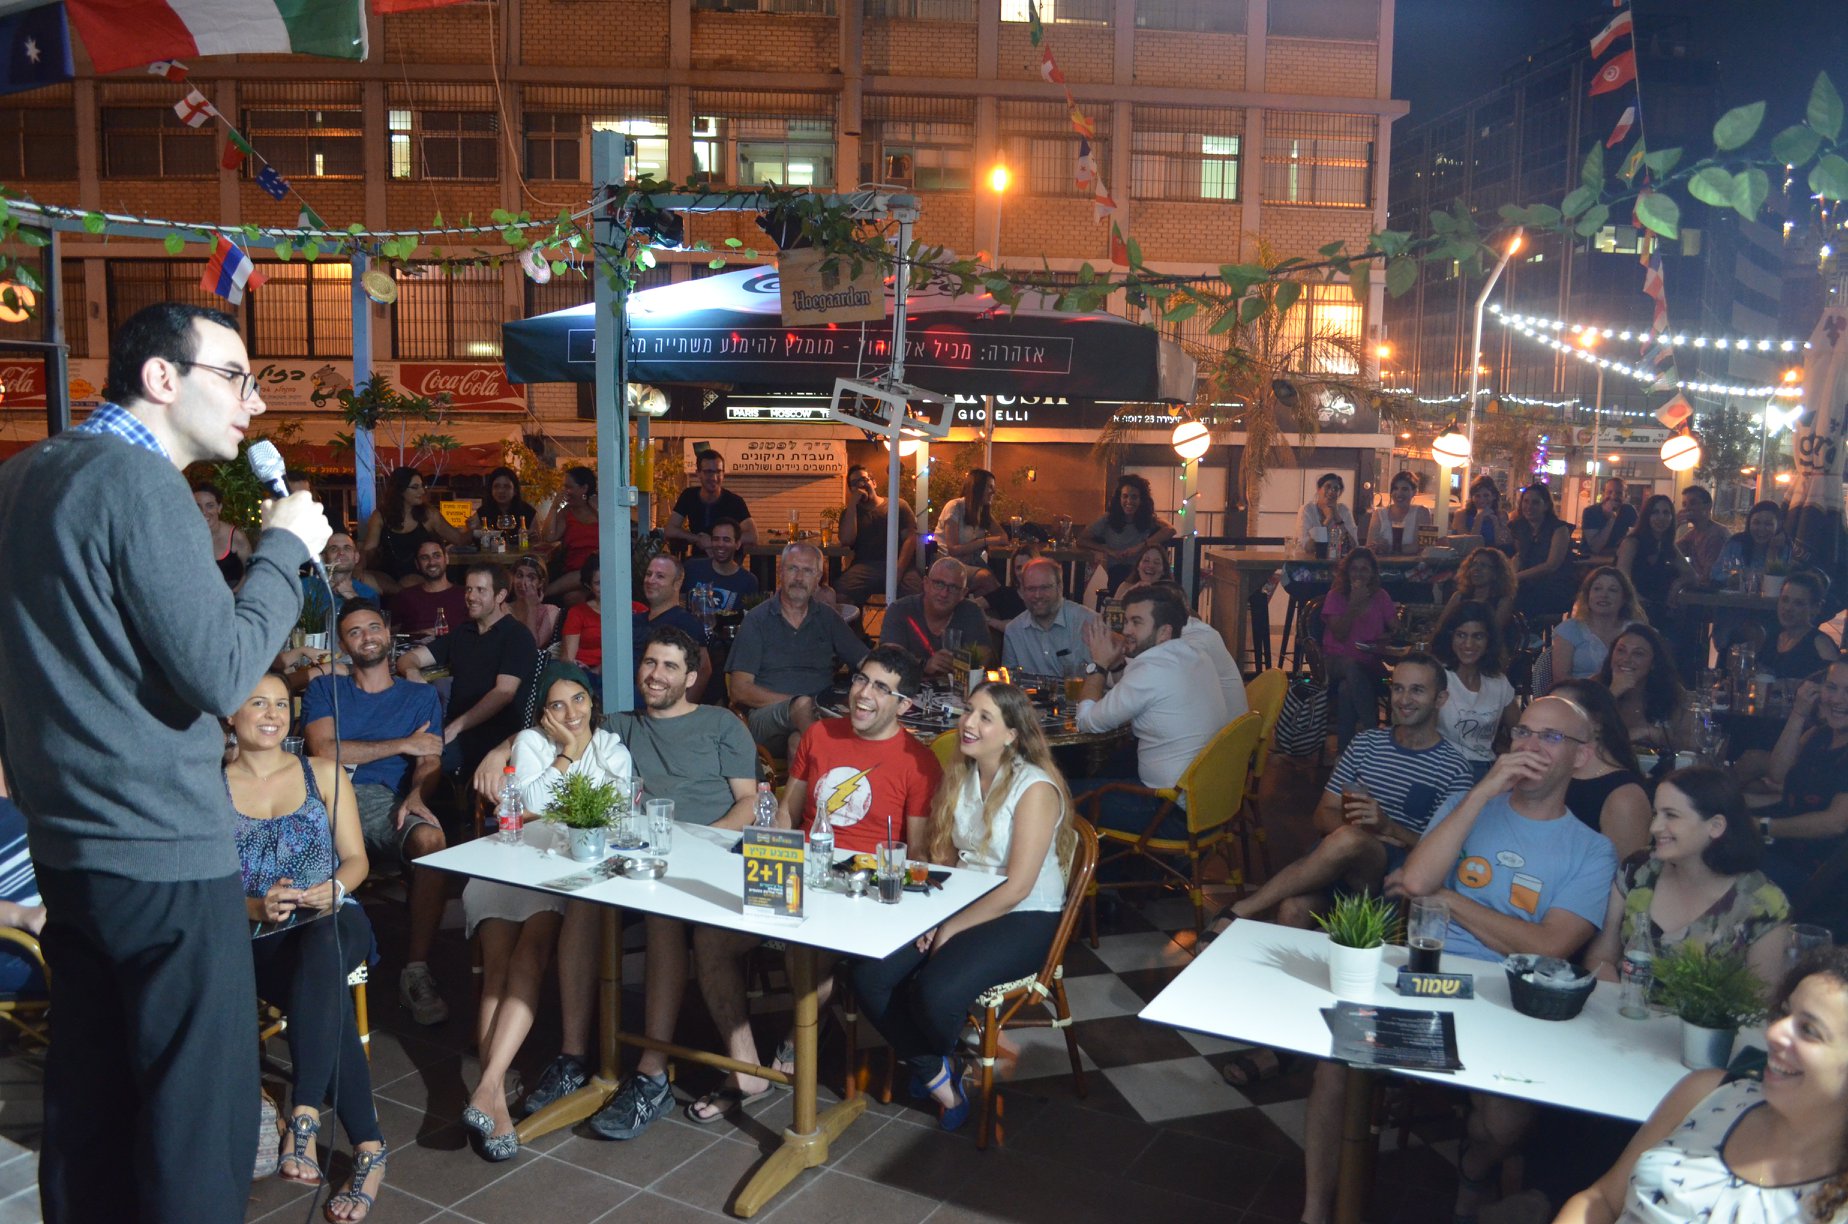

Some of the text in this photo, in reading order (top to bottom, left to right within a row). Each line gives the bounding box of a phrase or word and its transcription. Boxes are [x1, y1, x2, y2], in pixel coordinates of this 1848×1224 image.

[792, 286, 871, 312] Hoegaarden
[654, 336, 712, 354] משתייה
[719, 335, 777, 354] להימנע
[785, 336, 834, 357] מומלץ
[858, 336, 925, 358] אלוהול
[934, 338, 972, 359] מכיל
[981, 343, 1045, 364] אזהרה:
[420, 368, 503, 397] Coca-Cola
[733, 409, 759, 418] PARIS
[770, 409, 812, 418] MOSCOW
[957, 409, 1028, 421] GIOELLI
[741, 452, 835, 462] מעבדת תיקונים
[732, 462, 844, 472] למחשבים ניידים ושולחניים
[749, 845, 799, 860] מבצע קיץ
[747, 859, 783, 885] 2+1
[1411, 976, 1460, 995] שמור
